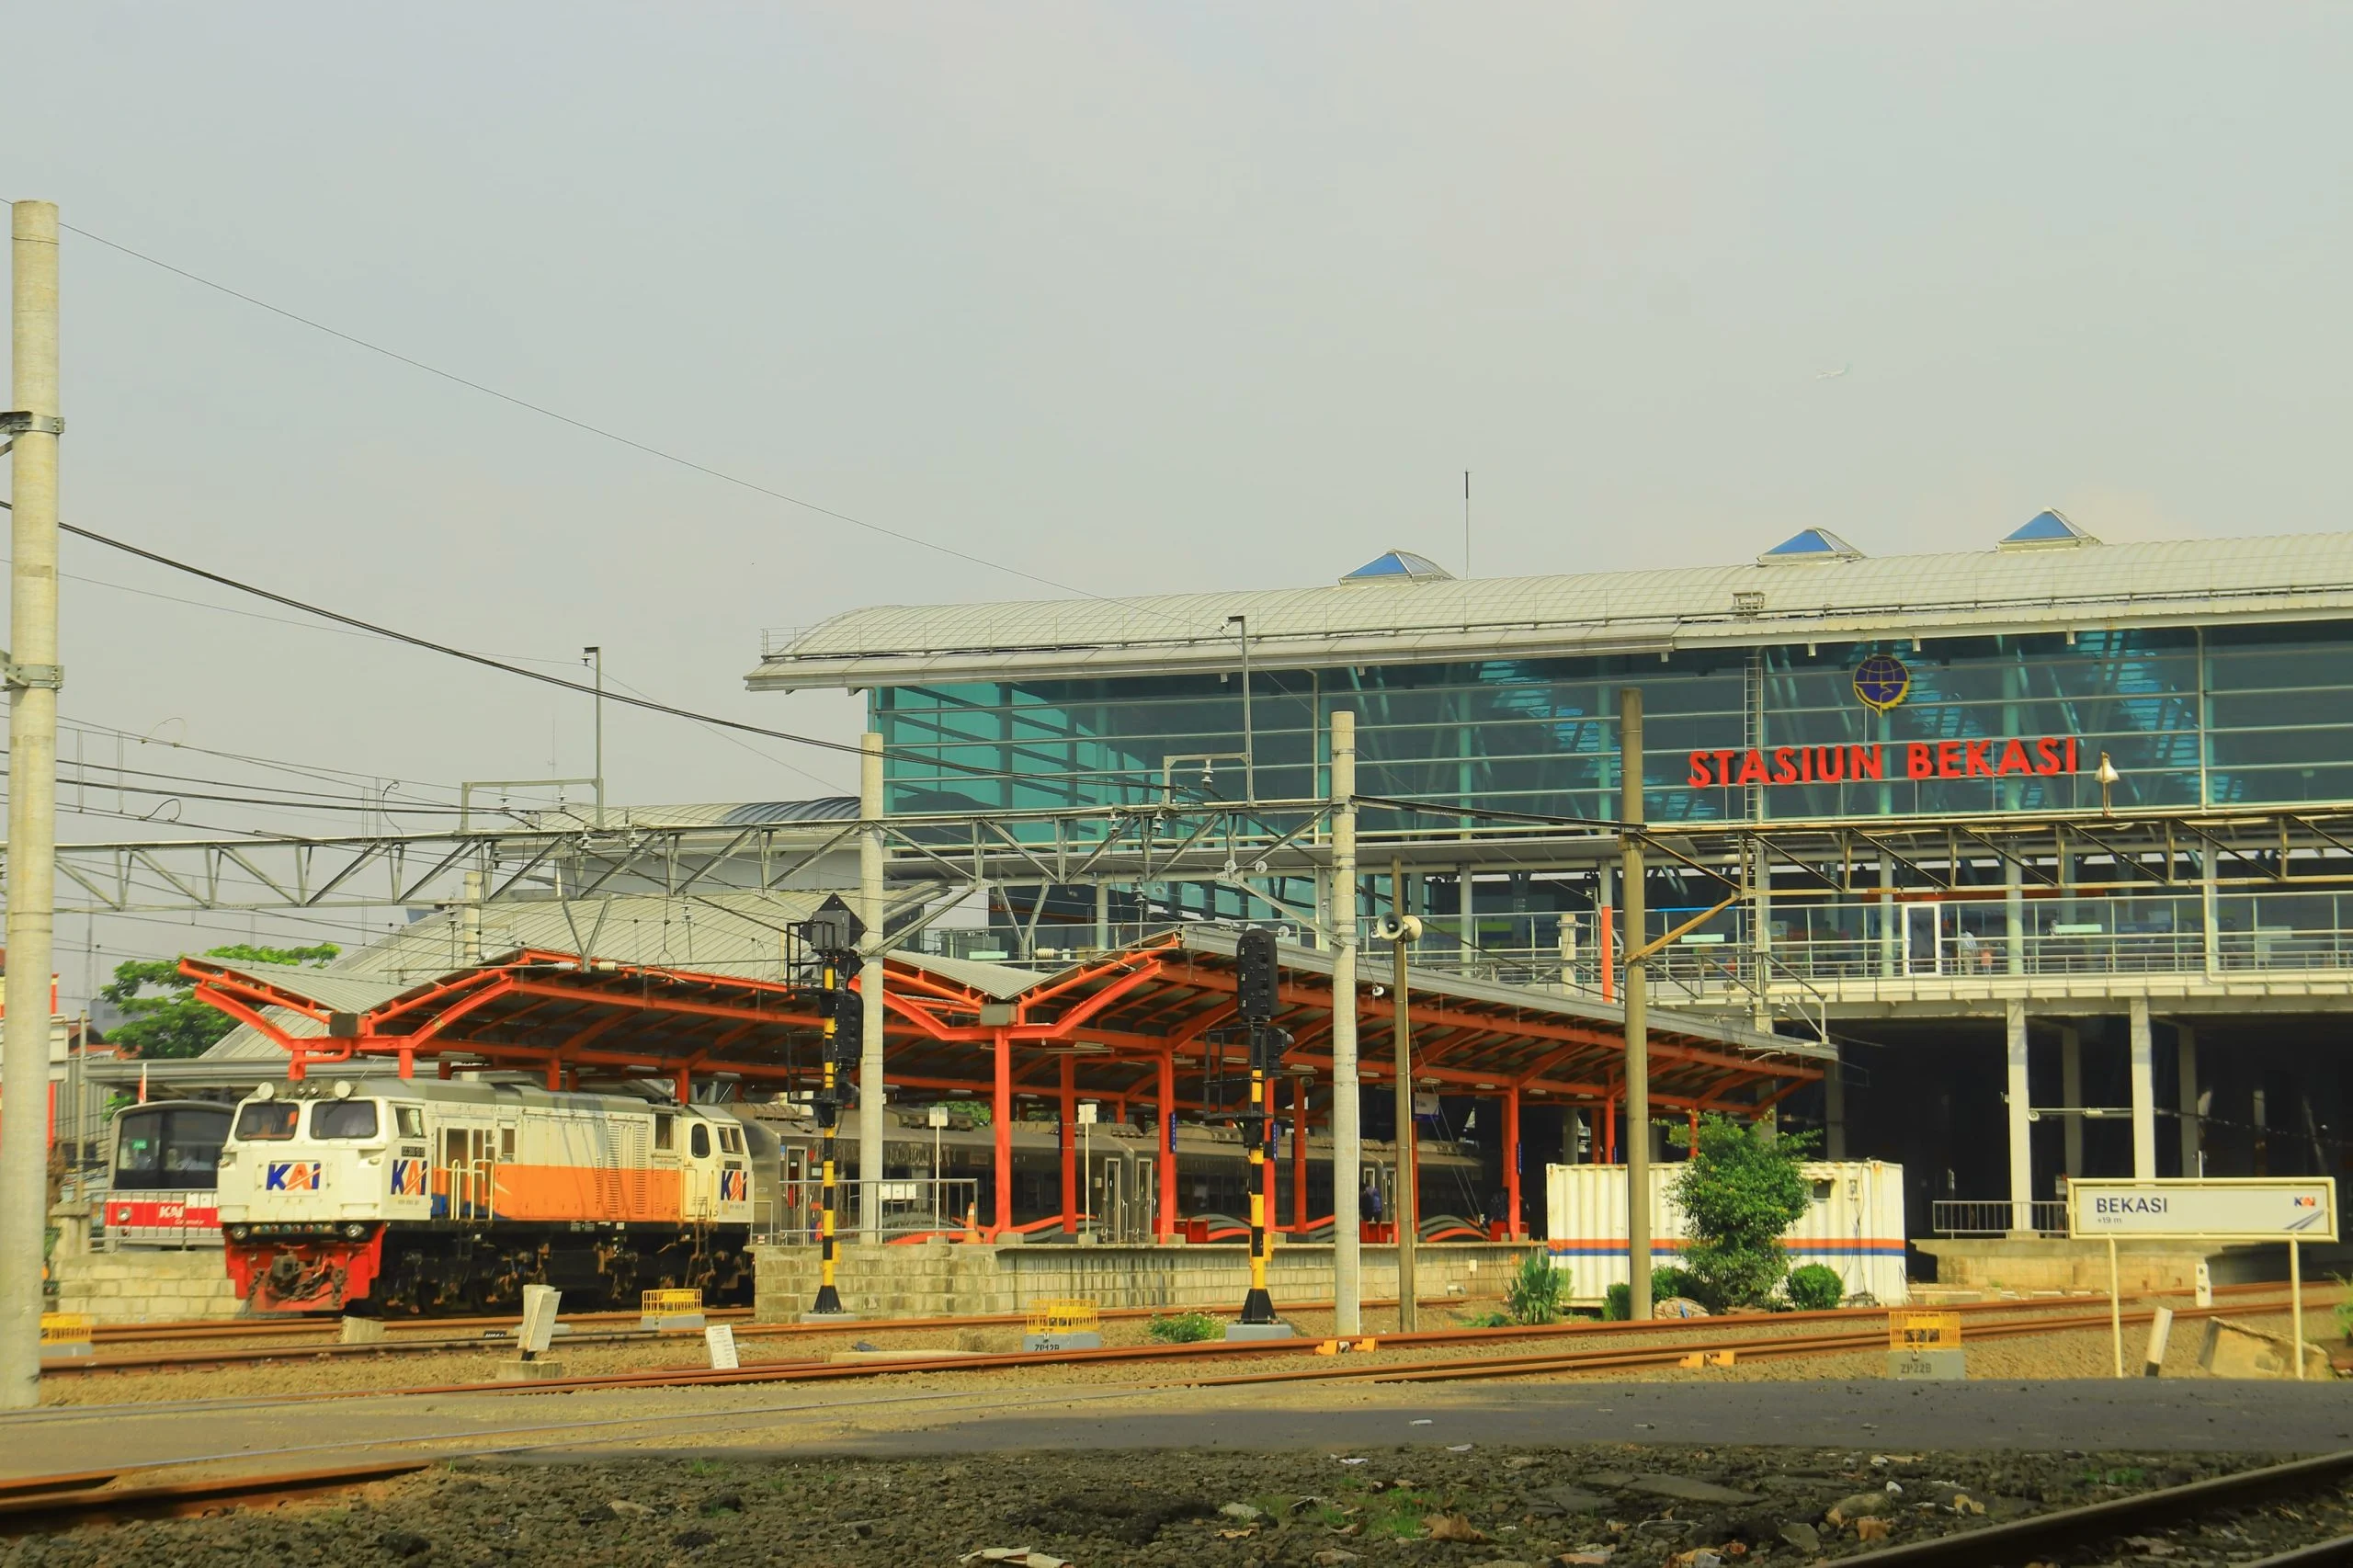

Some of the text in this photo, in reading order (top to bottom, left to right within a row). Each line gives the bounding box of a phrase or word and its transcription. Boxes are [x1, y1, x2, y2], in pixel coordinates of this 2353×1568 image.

[1688, 737, 2076, 788] STASIUN BEKASI
[266, 1163, 322, 1191] KAI
[392, 1159, 428, 1196] KAI
[721, 1170, 747, 1201] KAI
[2096, 1197, 2168, 1213] BEKASI
